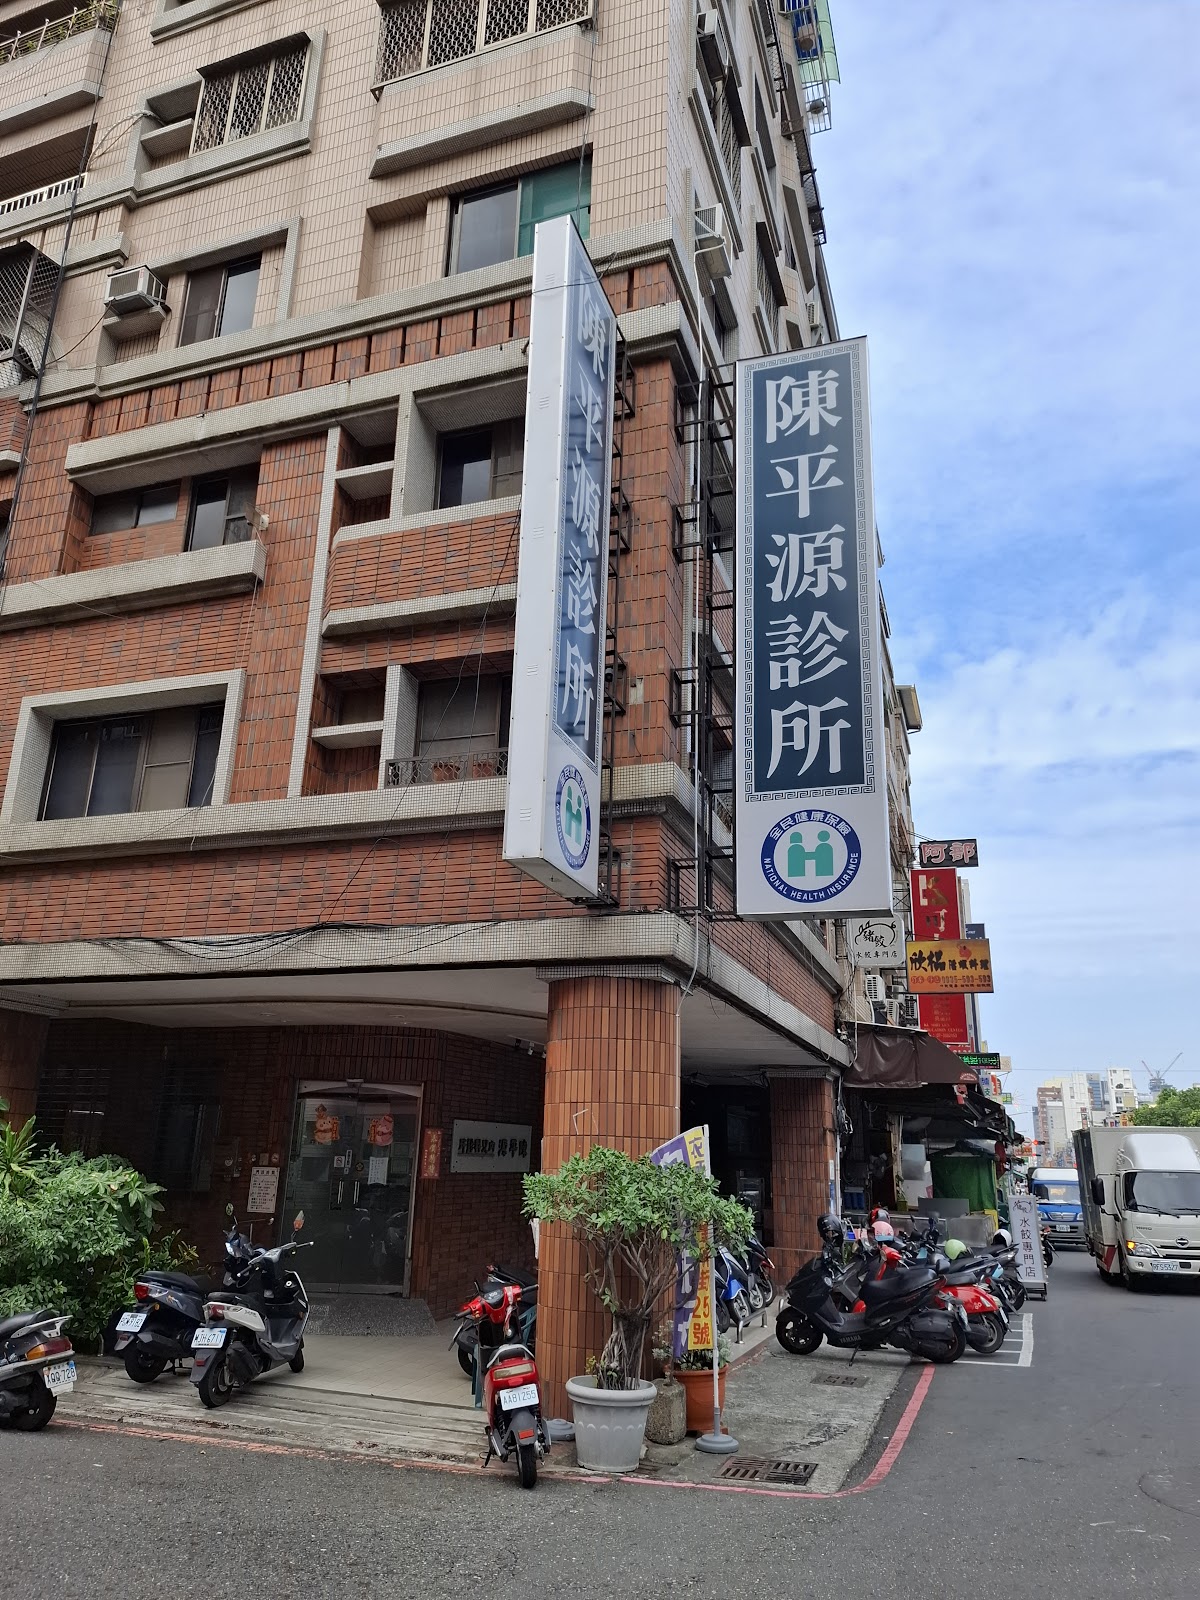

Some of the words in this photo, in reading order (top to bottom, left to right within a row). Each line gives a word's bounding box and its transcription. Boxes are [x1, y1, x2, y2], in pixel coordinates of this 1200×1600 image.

[562, 270, 606, 740] 陳平源診所
[765, 369, 853, 779] 陳平源診所
[769, 811, 852, 840] 全民健康保險
[921, 842, 976, 864] 阿部
[763, 858, 788, 894] NATIONAL
[790, 890, 825, 900] HEALTH
[827, 852, 859, 895] INSURANCE
[855, 950, 898, 959] 水餃專門店
[1020, 1217, 1036, 1278] 水餃專門店
[839, 1334, 862, 1344] YAMAHA
